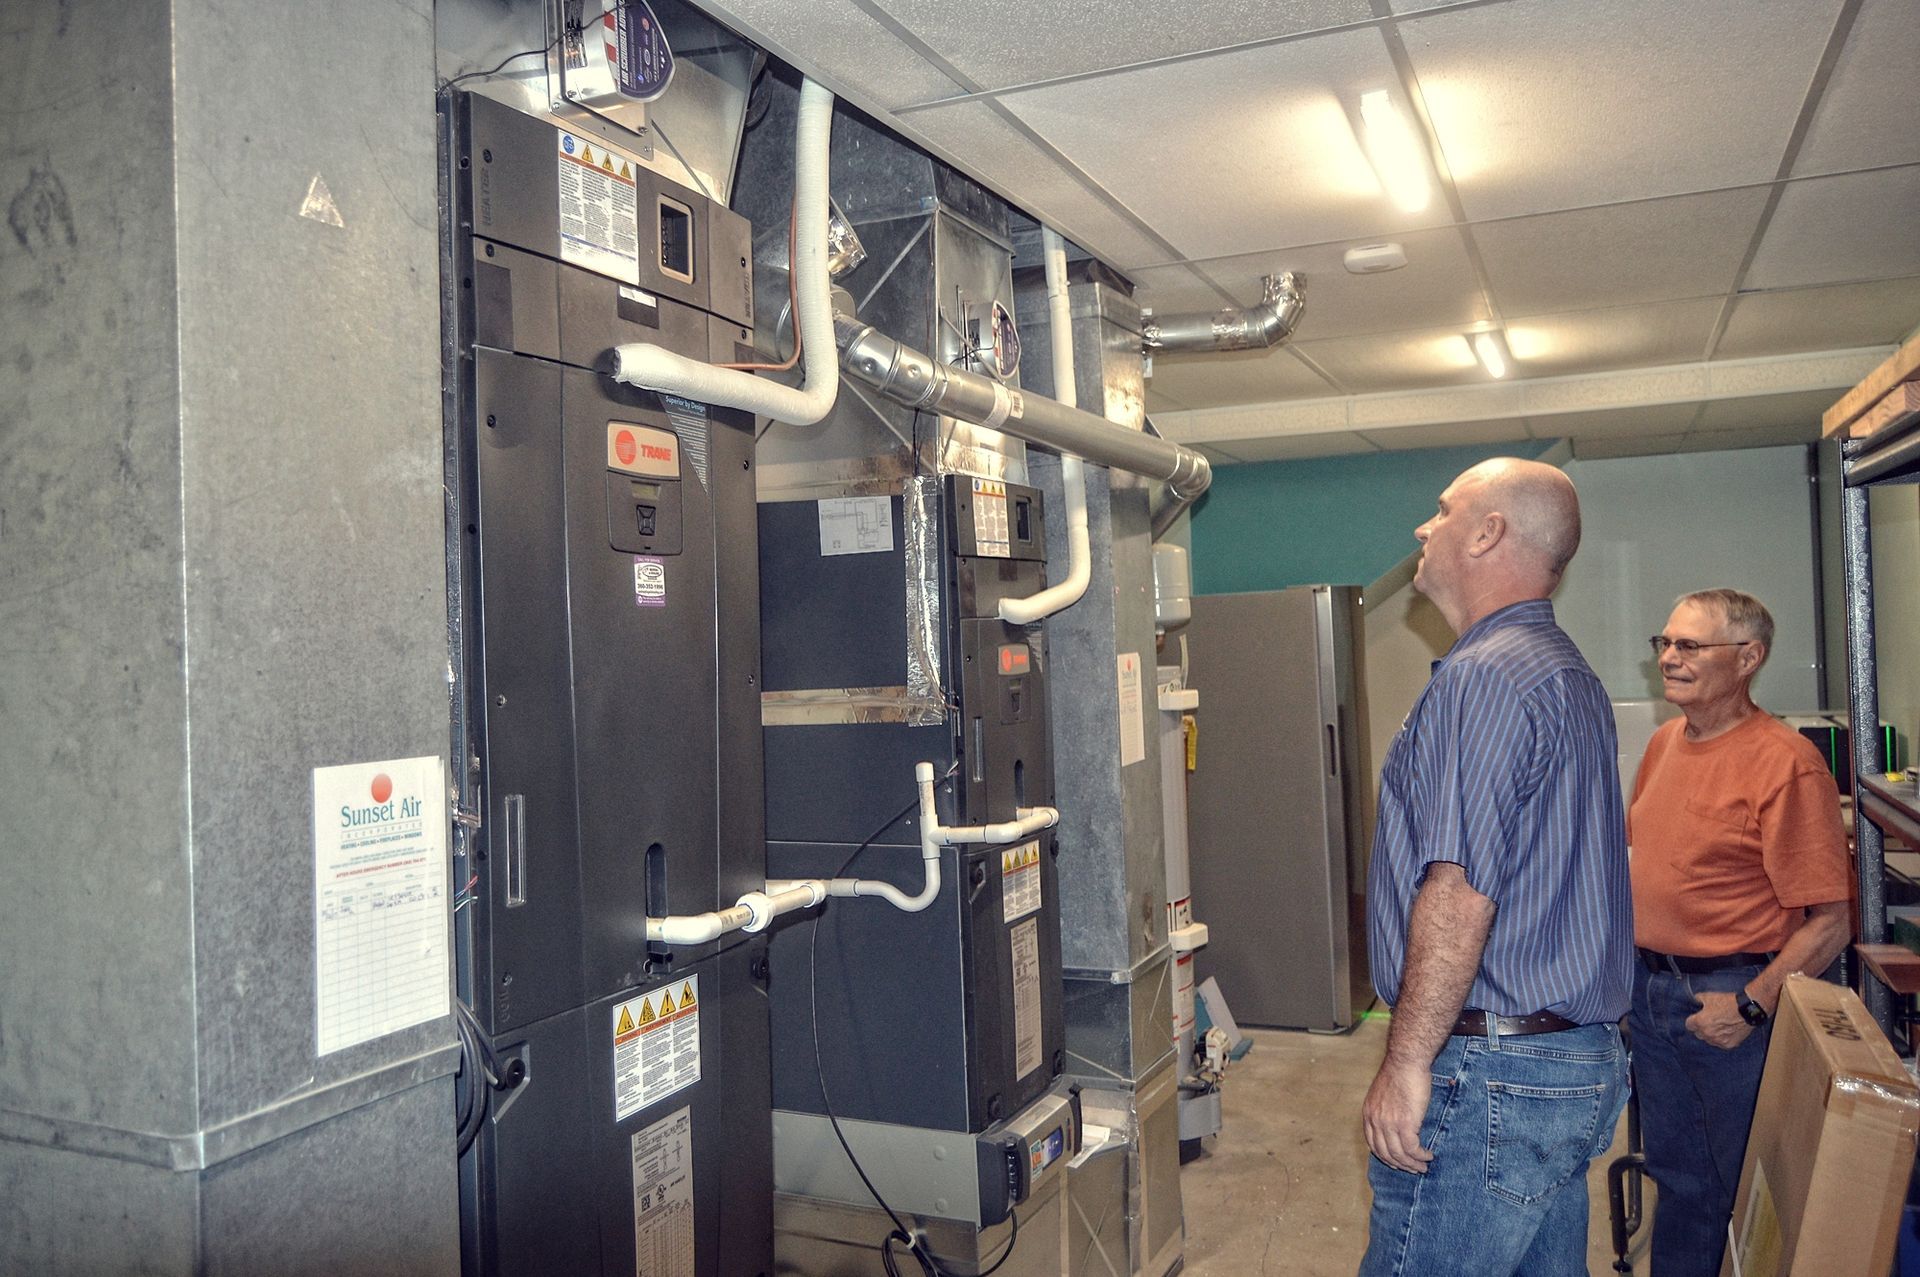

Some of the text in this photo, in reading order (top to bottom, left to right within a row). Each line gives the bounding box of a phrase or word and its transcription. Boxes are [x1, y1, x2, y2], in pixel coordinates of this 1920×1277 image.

[620, 30, 629, 72] SCRUBBER
[622, 71, 630, 86] AIR
[665, 395, 684, 406] Superior
[641, 444, 672, 461] TRANE
[341, 796, 422, 827] Sunset Air
